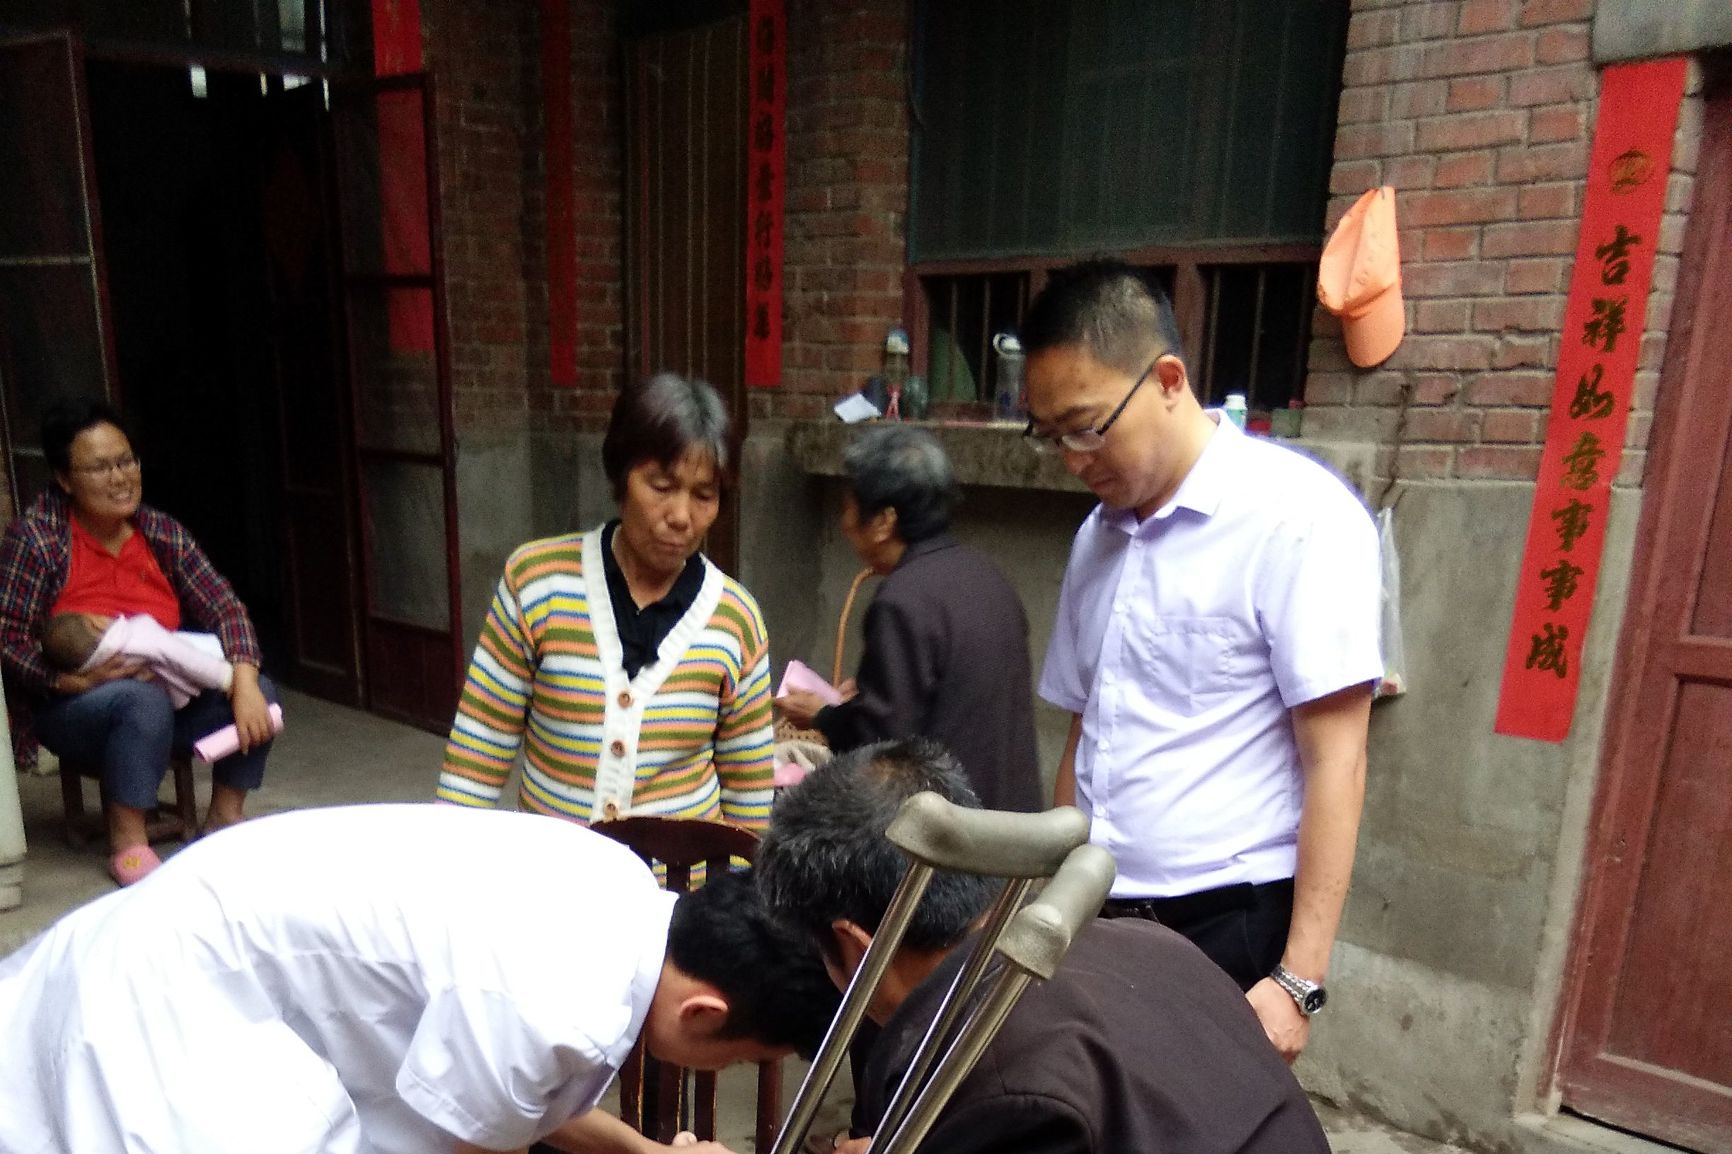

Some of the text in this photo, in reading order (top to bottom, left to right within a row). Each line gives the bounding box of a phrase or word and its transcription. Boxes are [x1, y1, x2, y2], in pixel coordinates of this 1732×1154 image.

[1525, 224, 1642, 680] 吉祥如意事事成
